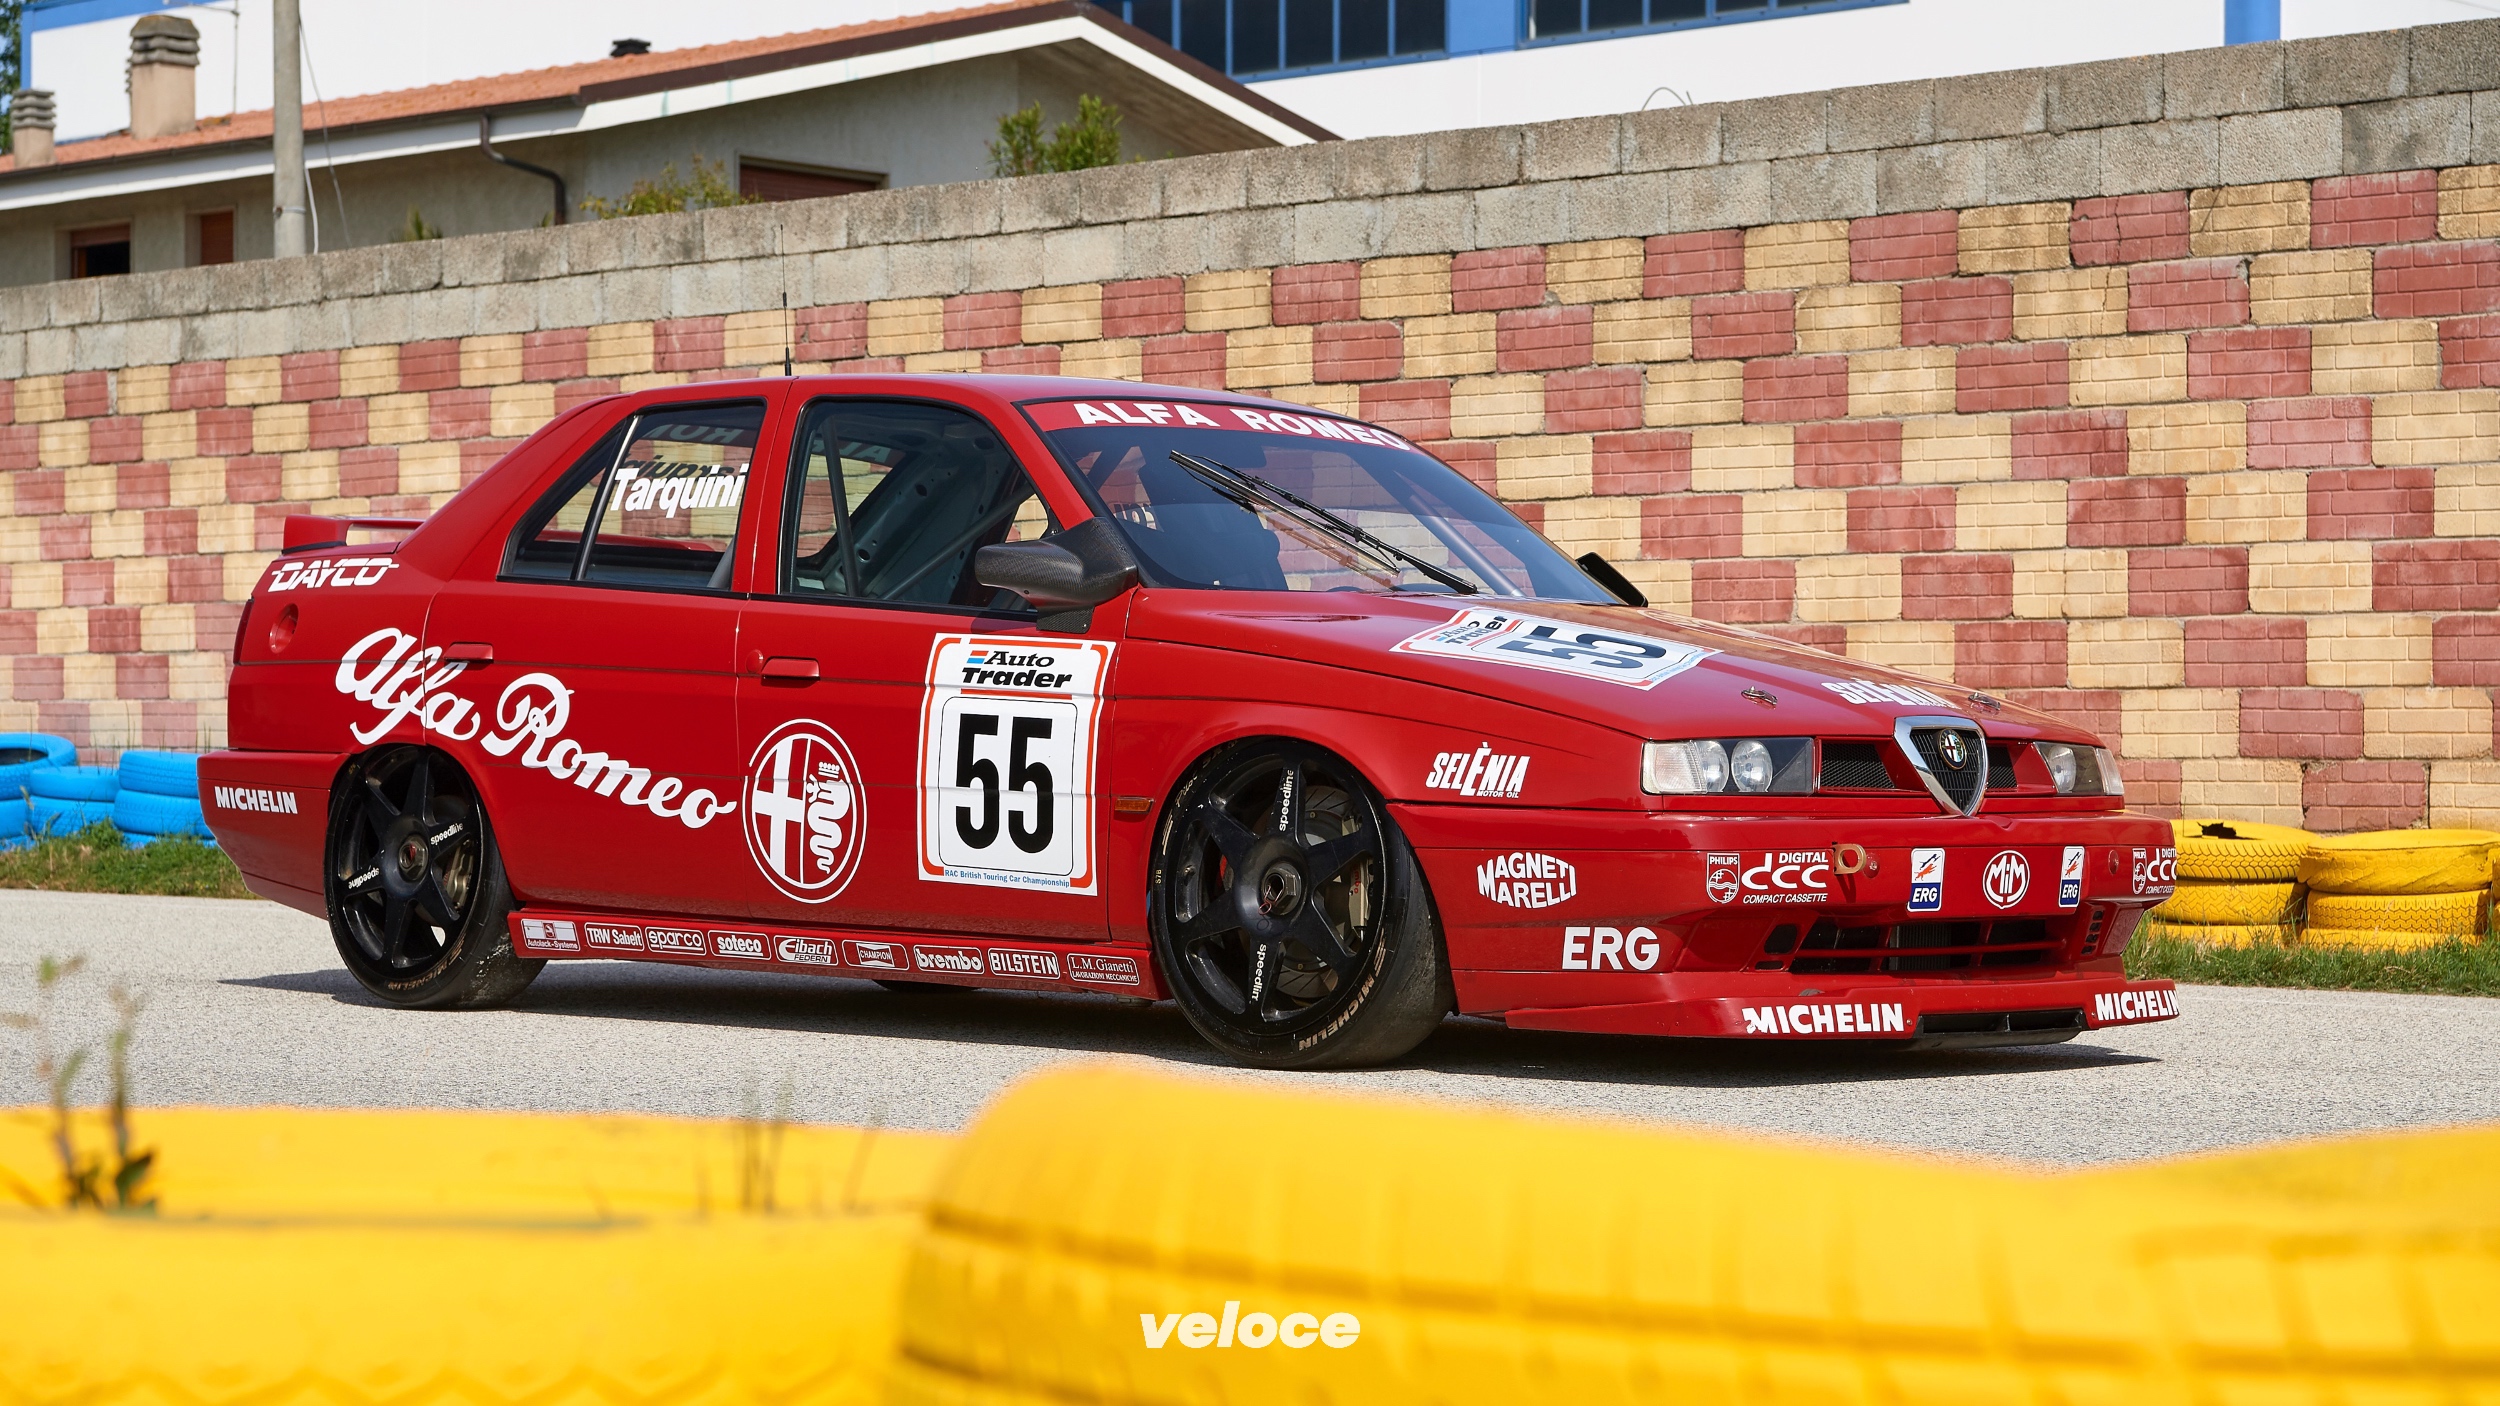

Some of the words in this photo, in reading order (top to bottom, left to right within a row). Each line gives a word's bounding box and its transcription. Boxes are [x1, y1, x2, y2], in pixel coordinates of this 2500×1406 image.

[1073, 403, 1221, 427] ALFA
[1229, 408, 1411, 451] ROMEO
[610, 463, 750, 518] Tarquini
[268, 558, 399, 592] DAYCO
[1444, 615, 1508, 644] Trader
[984, 650, 1055, 667] Auto
[1496, 625, 1667, 669] 55
[962, 667, 1073, 688] Trader
[335, 627, 481, 745] Alfa
[481, 672, 737, 829] Romeo
[956, 713, 1053, 853] 55
[214, 786, 298, 814] MICHELIN
[1279, 769, 1294, 832] speedline
[1709, 856, 1738, 865] PHILIPS
[1779, 852, 1828, 863] DIGITAL
[945, 869, 958, 877] RAC
[960, 870, 981, 879] British
[983, 872, 1008, 883] Touring
[1009, 874, 1020, 882] Car
[1022, 876, 1070, 888] Championship
[1477, 852, 1577, 890] MAGNETI
[1741, 852, 1829, 889] dcc
[1477, 872, 1577, 909] MARELLI
[1743, 894, 1785, 904] COMPACT
[1785, 893, 1828, 903] CASSETTE
[1912, 887, 1938, 903] ERG
[2061, 884, 2078, 899] ERG
[586, 928, 611, 944] TRW
[612, 929, 643, 947] Sabelt
[649, 930, 702, 950] sparco
[717, 935, 762, 953] soteco
[779, 938, 833, 958] Eibach
[1562, 927, 1660, 970] ERG
[794, 954, 828, 963] FEDERN
[860, 949, 892, 960] CHAMPION
[916, 948, 982, 970] brembo
[990, 952, 1059, 975] BILSTEIN
[1298, 974, 1375, 1051] MICHELIN
[2095, 990, 2179, 1021] MICHELIN
[1742, 1003, 1904, 1034] MICHELIN
